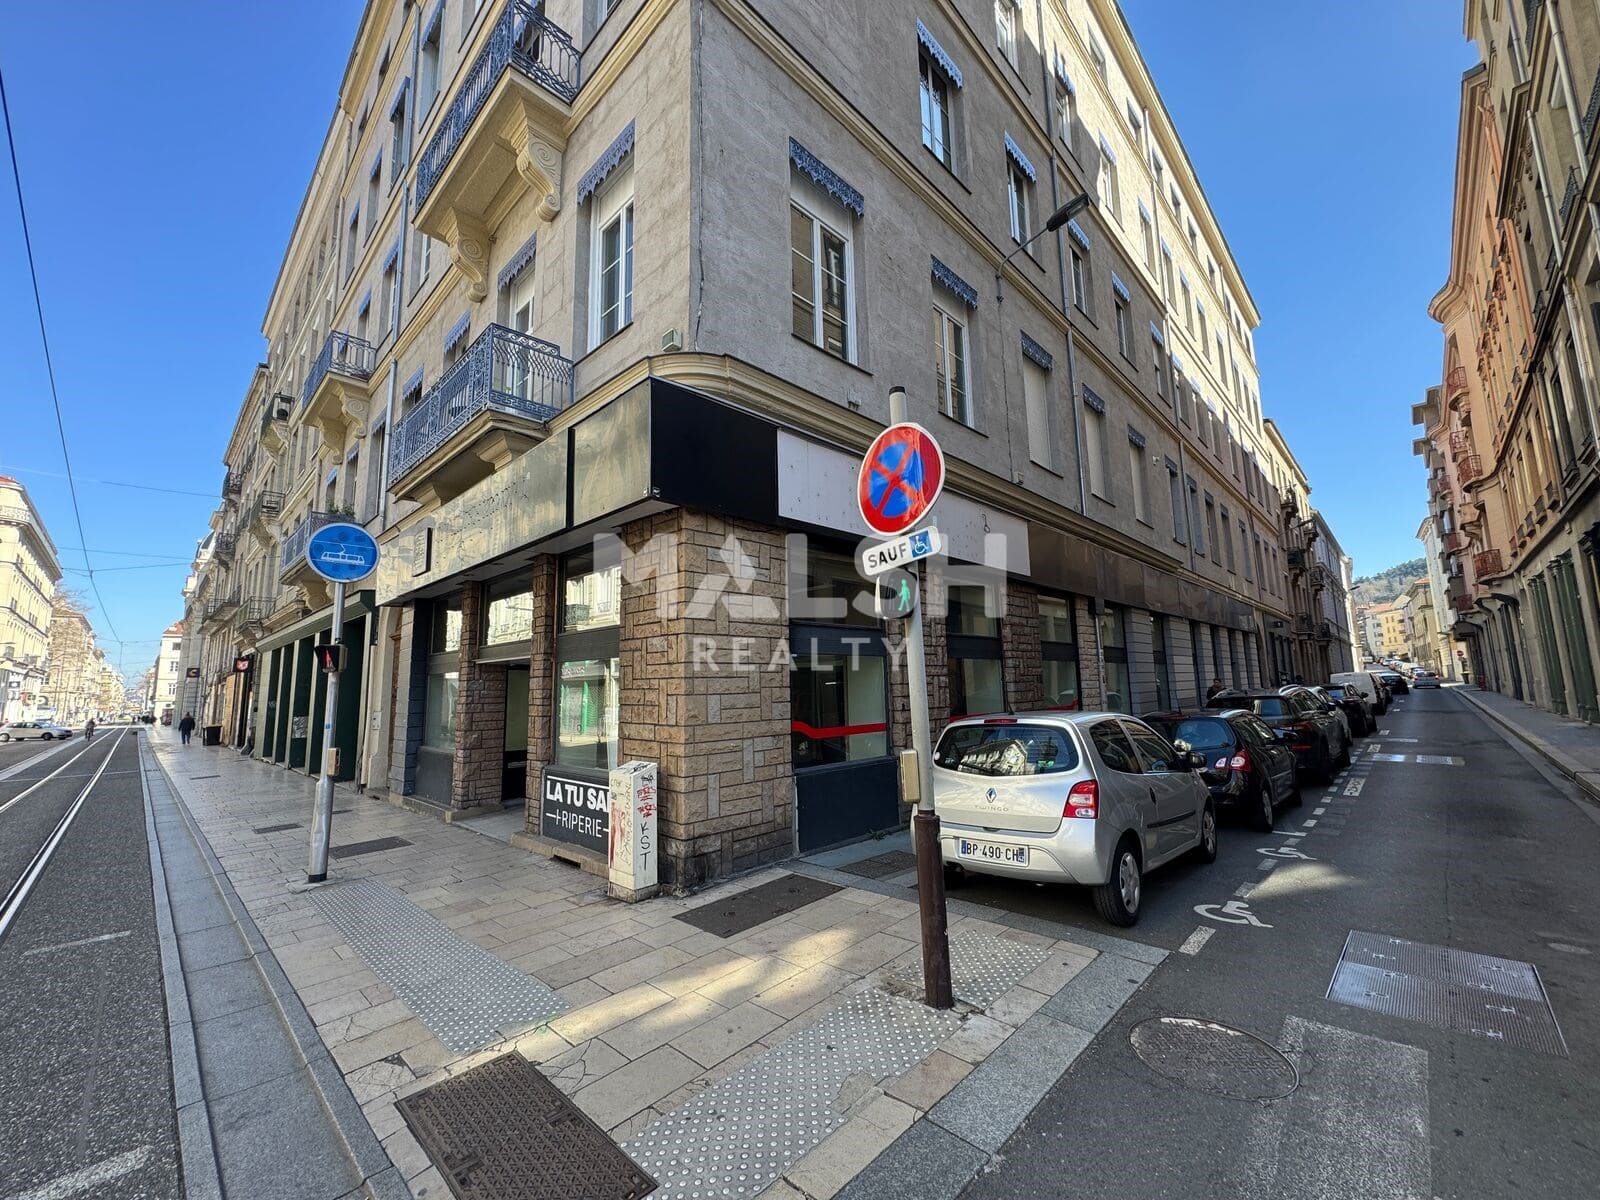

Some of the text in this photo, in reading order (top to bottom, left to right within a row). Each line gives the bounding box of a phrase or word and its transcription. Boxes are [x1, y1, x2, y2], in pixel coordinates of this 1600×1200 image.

[868, 543, 907, 568] SAUF
[546, 780, 609, 813] LA TU SA
[974, 804, 1009, 812] TWINGO
